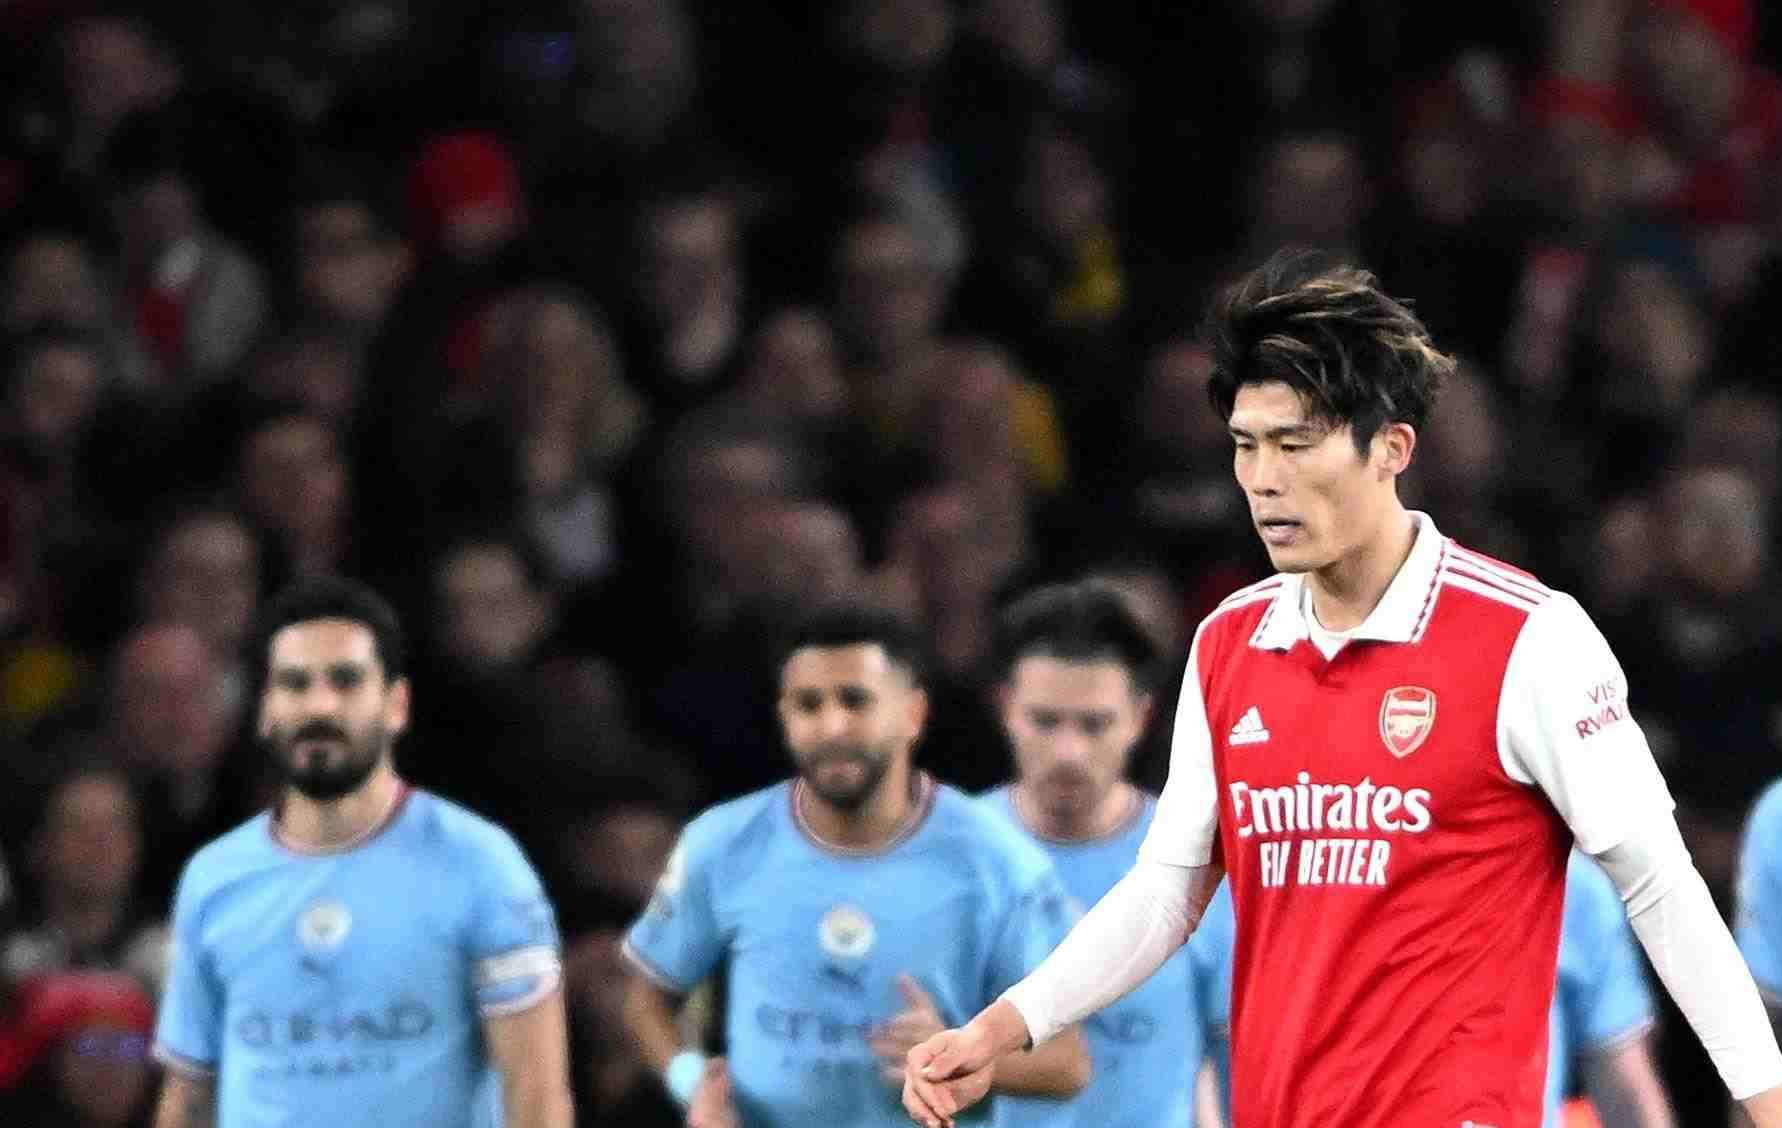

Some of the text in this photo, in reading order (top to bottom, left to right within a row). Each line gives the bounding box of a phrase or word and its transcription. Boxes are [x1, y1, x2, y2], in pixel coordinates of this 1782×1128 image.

[1575, 704, 1623, 740] RWA
[1229, 770, 1431, 837] Emirates
[1297, 838, 1392, 887] BETTER
